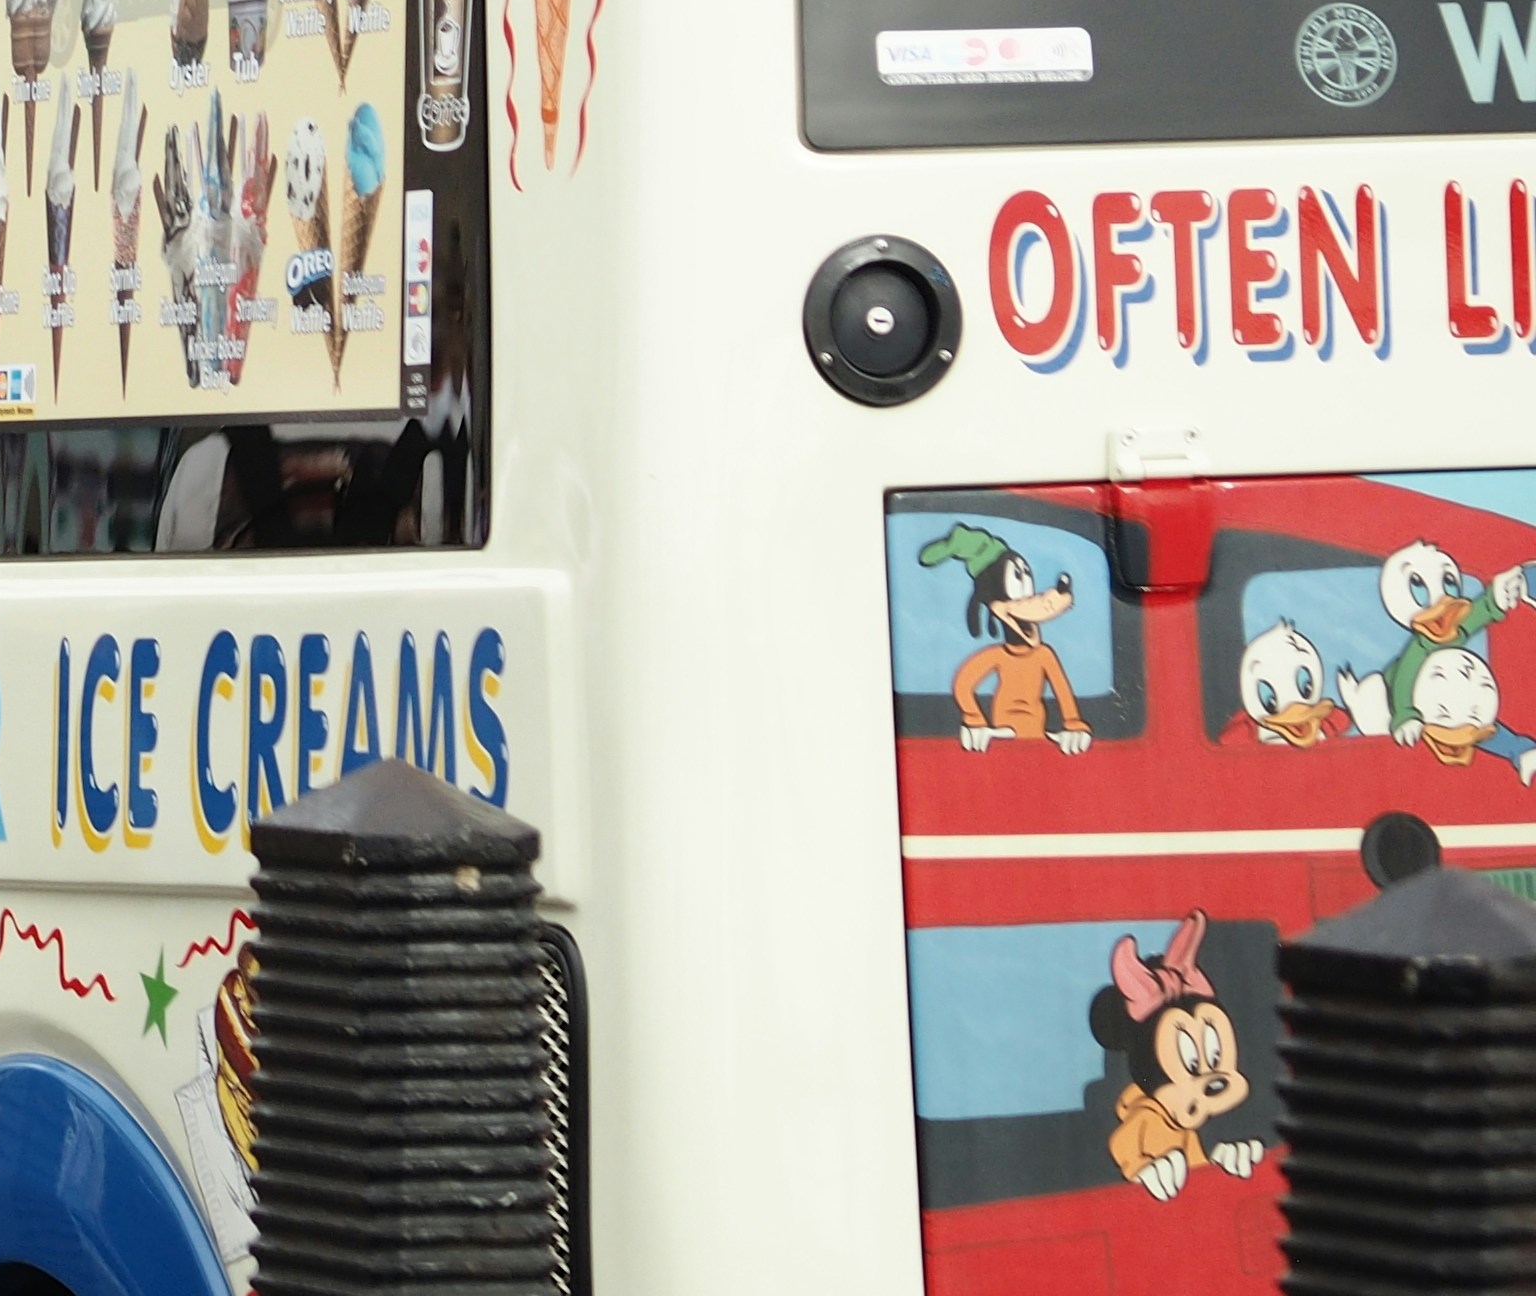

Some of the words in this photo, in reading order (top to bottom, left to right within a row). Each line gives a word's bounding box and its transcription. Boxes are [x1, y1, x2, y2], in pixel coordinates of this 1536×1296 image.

[284, 7, 326, 38] Waffle
[349, 2, 391, 34] Waffle
[169, 57, 210, 94] Oyster
[233, 51, 259, 83] Tub
[287, 249, 335, 296] OREO
[988, 184, 1391, 374] OFTEN
[42, 302, 75, 329] Waffle
[110, 298, 142, 325] Waffle
[290, 303, 332, 334] Waffle
[342, 303, 385, 333] Waffle
[201, 365, 231, 394] Glory
[52, 634, 161, 852] ICE
[191, 627, 511, 854] CREAMS
